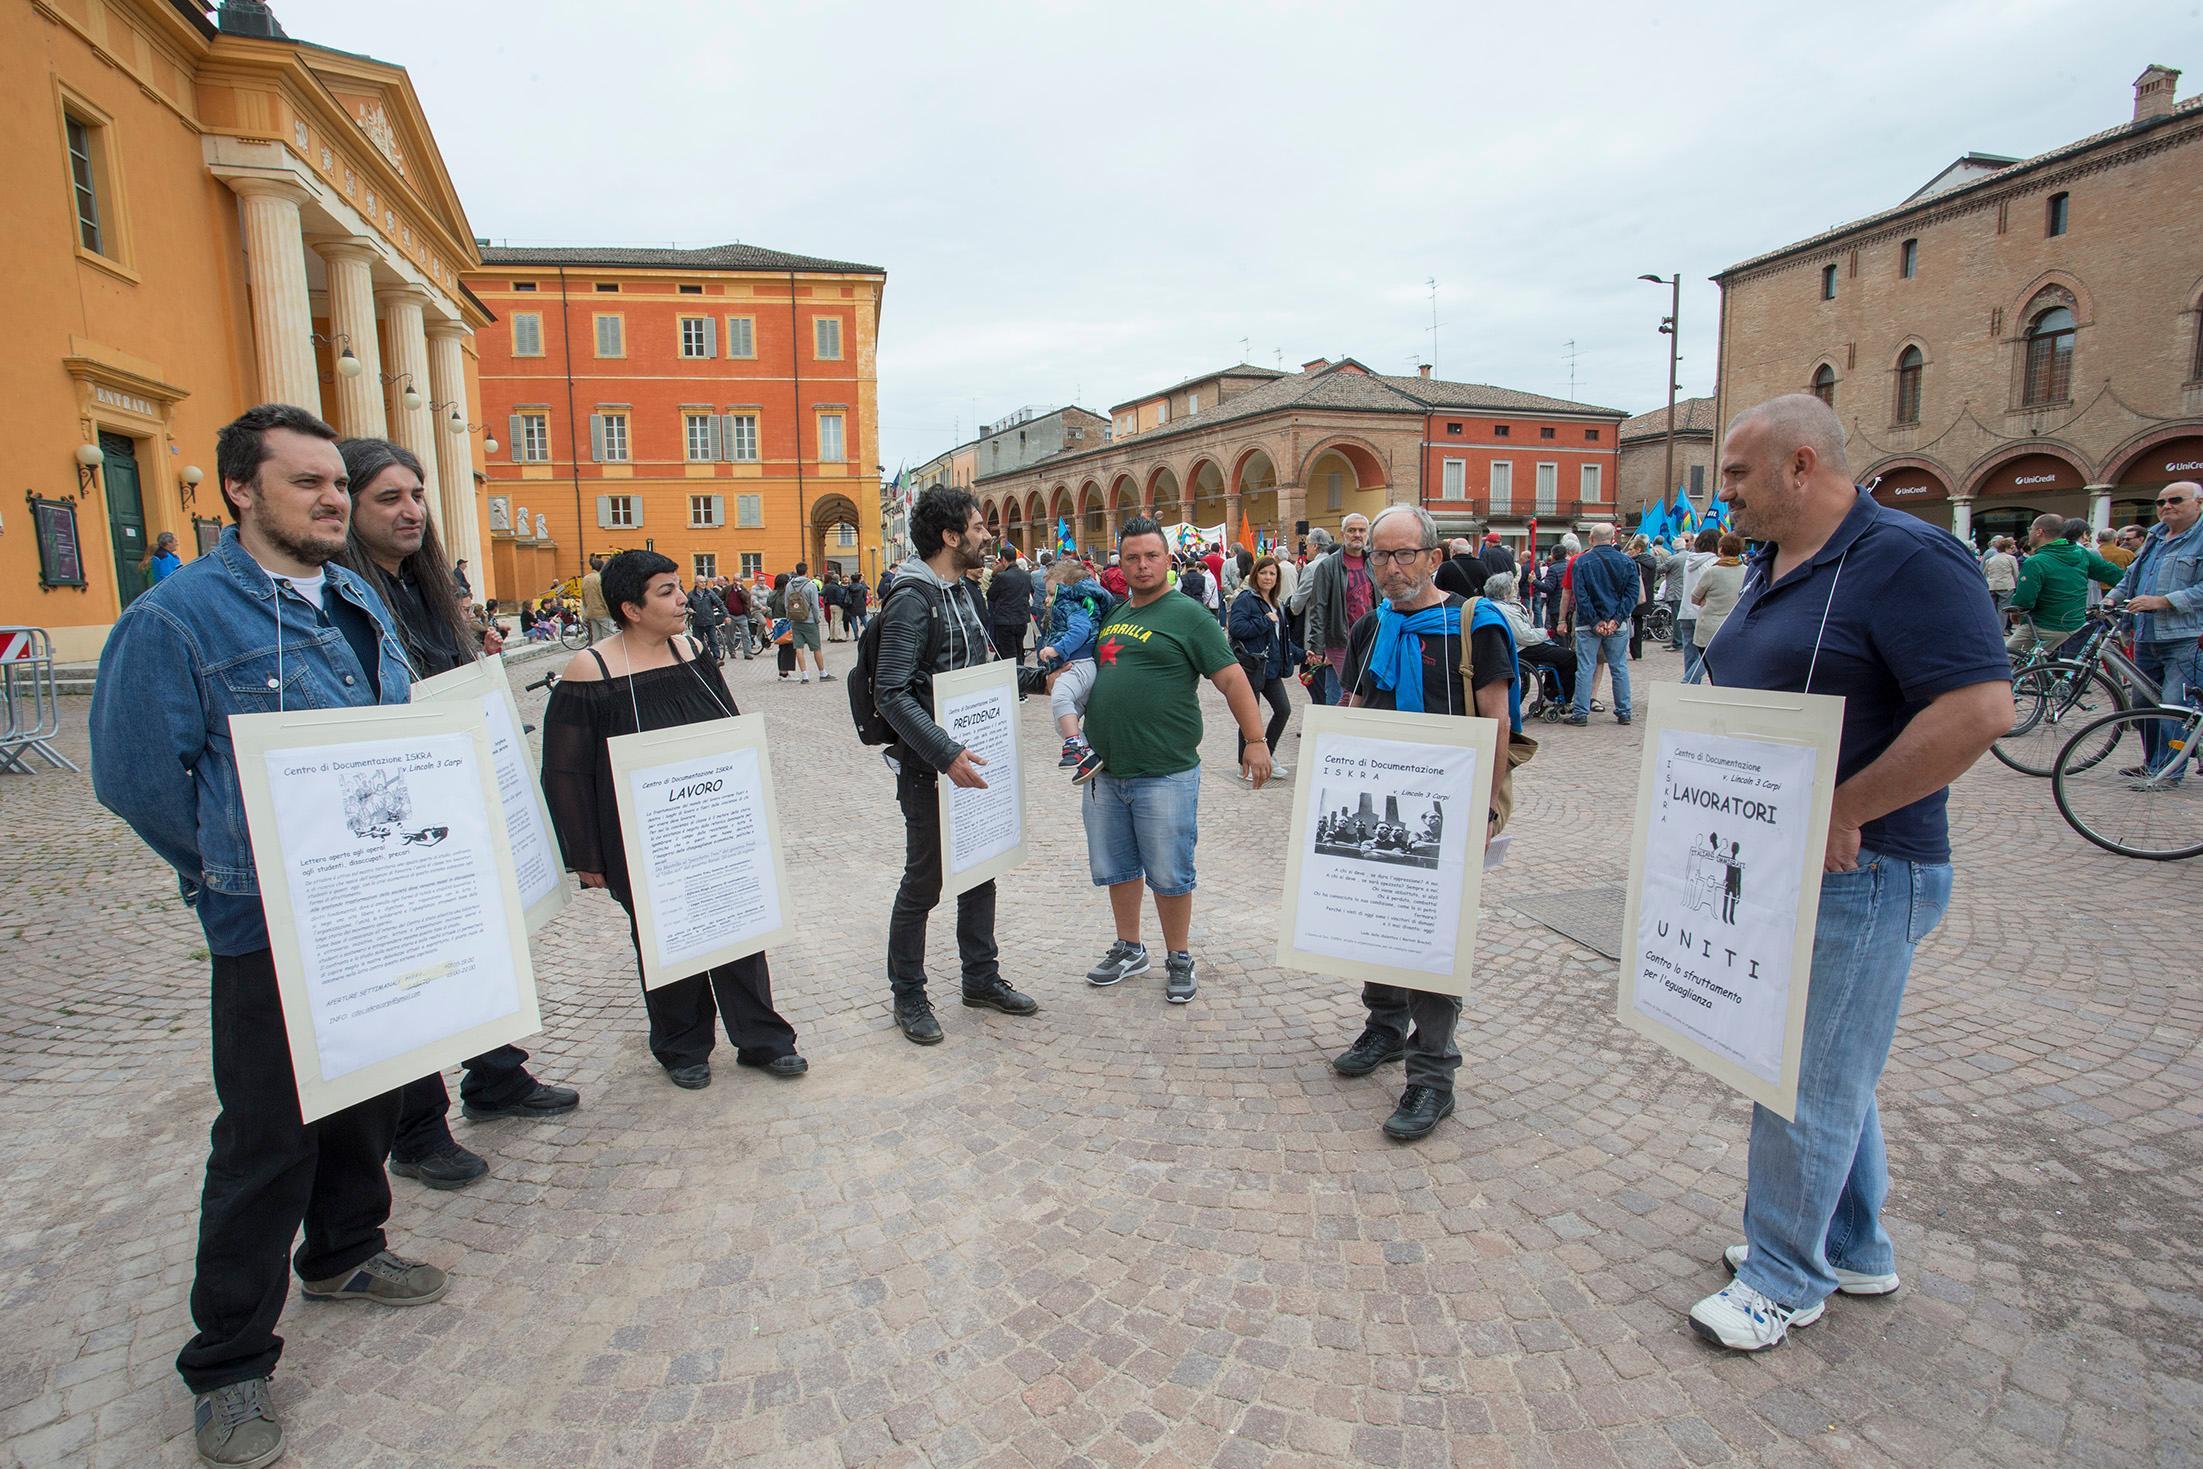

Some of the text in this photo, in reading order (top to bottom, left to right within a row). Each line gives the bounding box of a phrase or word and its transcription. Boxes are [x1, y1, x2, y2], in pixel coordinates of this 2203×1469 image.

[96, 387, 152, 416] ENTRATA
[2176, 461, 2203, 470] UniCre
[1901, 486, 1927, 494] UniCredit
[2023, 474, 2056, 485] UniCredit
[953, 706, 1000, 730] PREVIDENZA
[283, 751, 432, 776] Centro di Documentazione ISKRA
[408, 761, 433, 771] Lincoln
[443, 758, 463, 768] Carpi
[1324, 754, 1444, 775] Centro di Documentazione
[1674, 747, 1761, 772] Centro di Documentazione
[642, 779, 662, 789] Centro
[671, 768, 713, 783] Documentazione
[1730, 773, 1753, 786] Lincoln
[1754, 778, 1760, 787] 3
[1762, 779, 1781, 792] Carpi
[667, 778, 723, 802] LAVORO
[1401, 789, 1423, 797] Lincoln
[1432, 792, 1450, 801] Carpi
[1672, 782, 1778, 825] LAVORATORI
[1643, 965, 1713, 1011] per l'eguaglianza
[1645, 948, 1742, 1006] Contro lo sfruttamento
